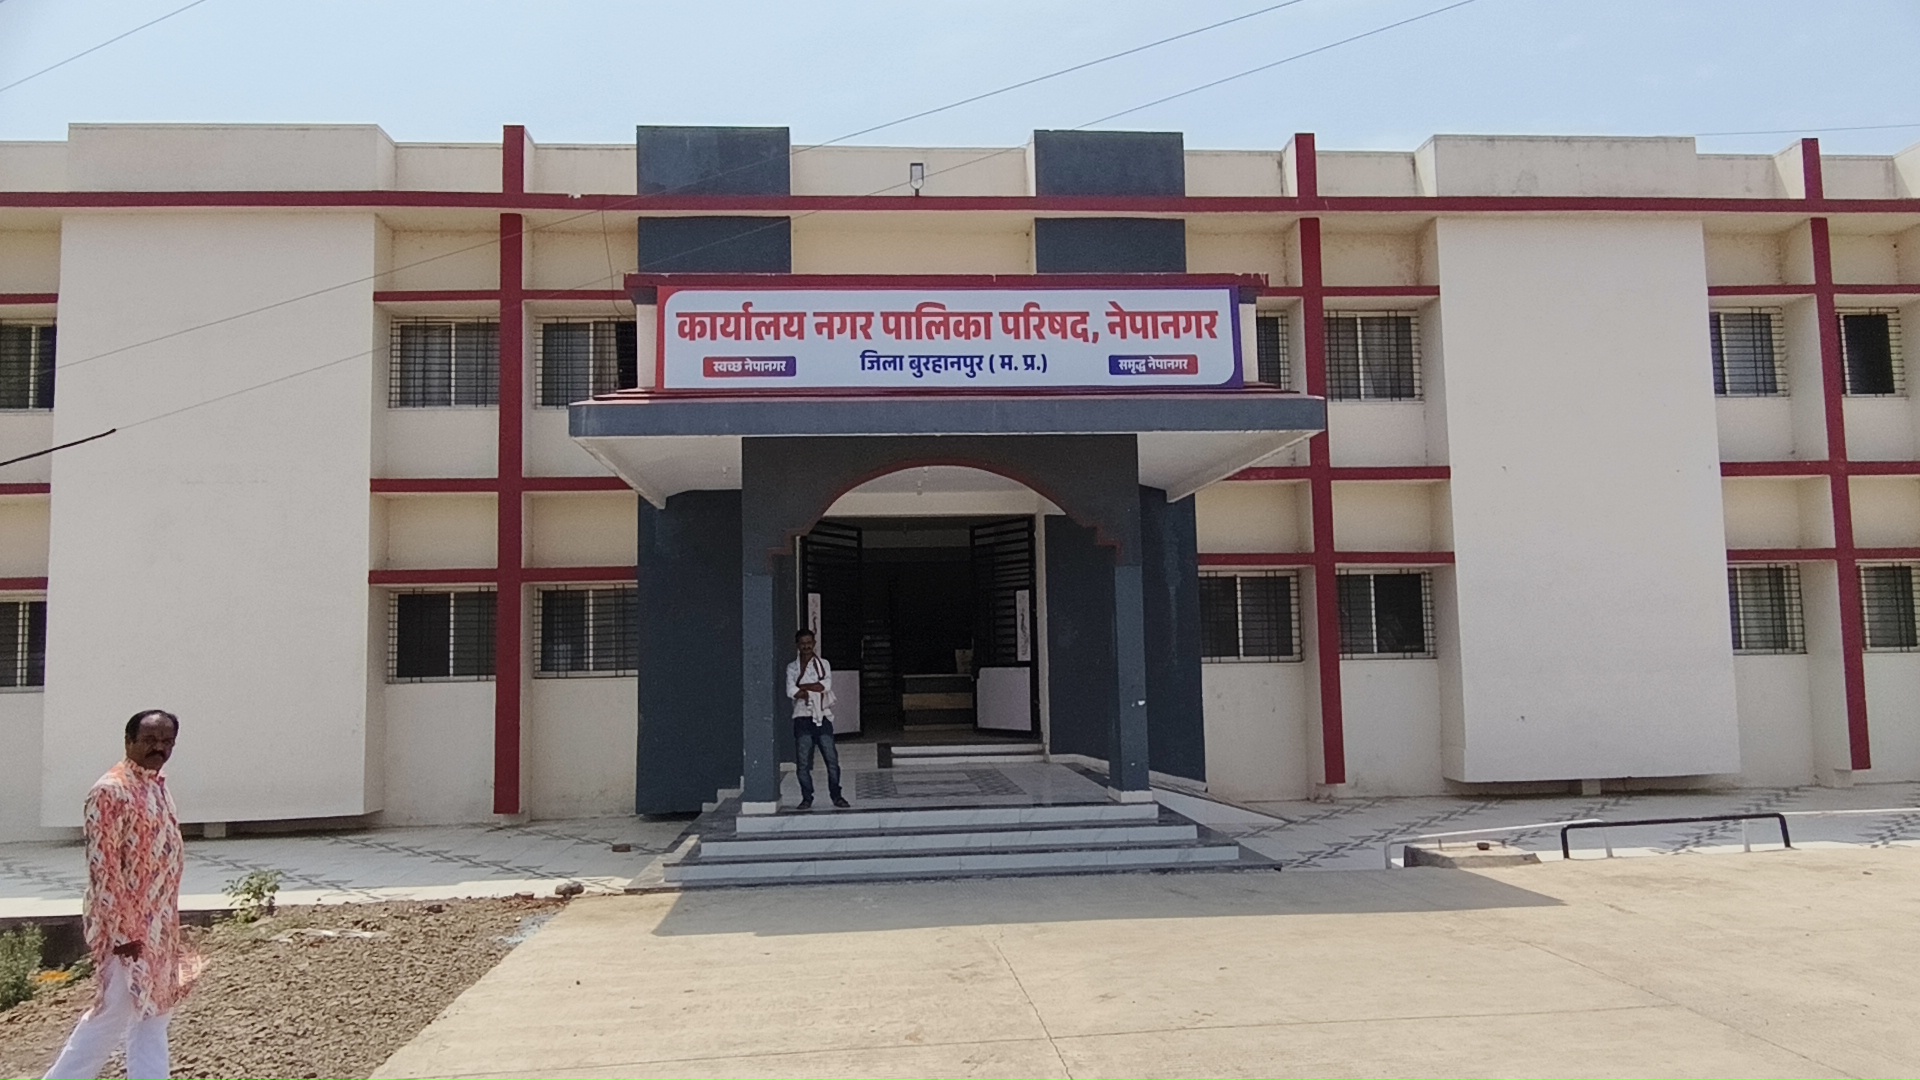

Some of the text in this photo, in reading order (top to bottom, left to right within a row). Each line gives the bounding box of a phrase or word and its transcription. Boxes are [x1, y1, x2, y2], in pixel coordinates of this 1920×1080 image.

[676, 301, 1219, 343] कार्यालय नगर पालिका परिषद, नेपानगर
[713, 357, 787, 372] स्वच्छ नेपानगर
[859, 349, 905, 371] जिला
[908, 354, 985, 378] बुरहानपुर
[1118, 356, 1188, 373] समृद्ध नेपानगर
